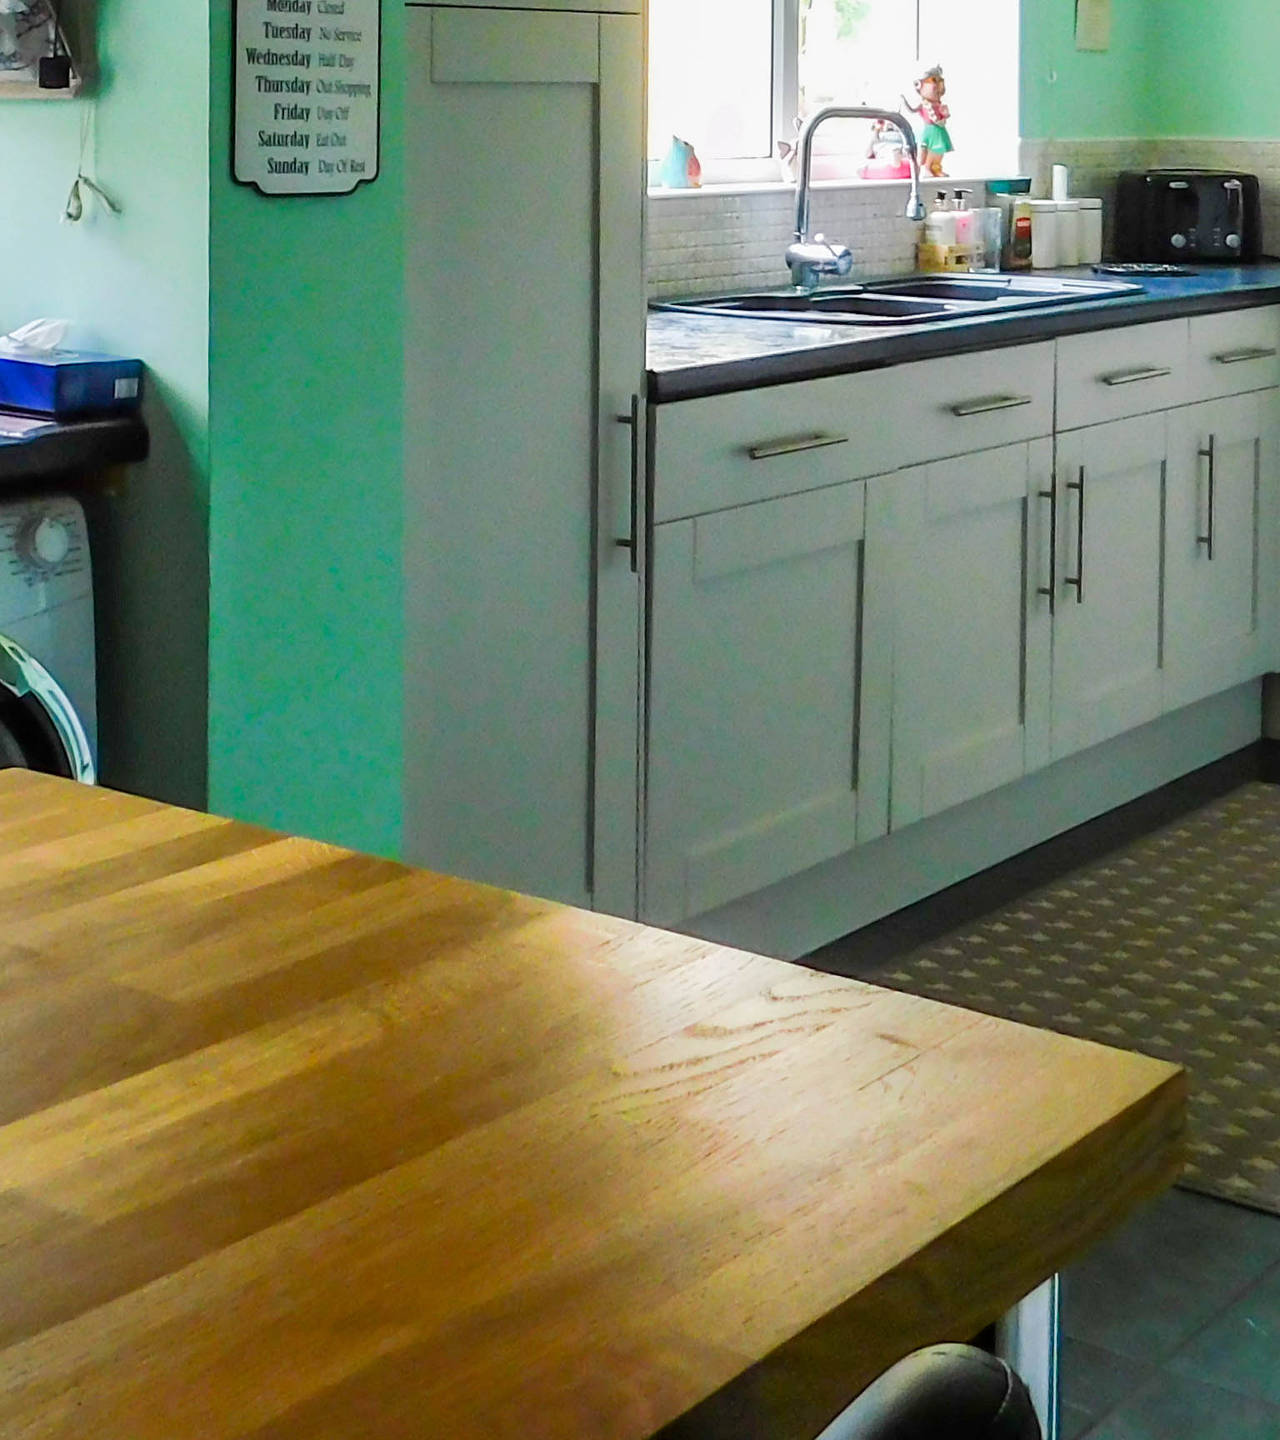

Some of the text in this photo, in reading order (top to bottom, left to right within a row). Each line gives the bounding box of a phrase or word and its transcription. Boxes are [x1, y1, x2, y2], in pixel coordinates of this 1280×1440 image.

[263, 21, 312, 43] Tuesday
[245, 47, 312, 70] Wednesday
[255, 75, 312, 97] Thursday
[273, 102, 311, 123] Friday
[258, 130, 310, 149] Saturday
[267, 157, 310, 176] Sunday
